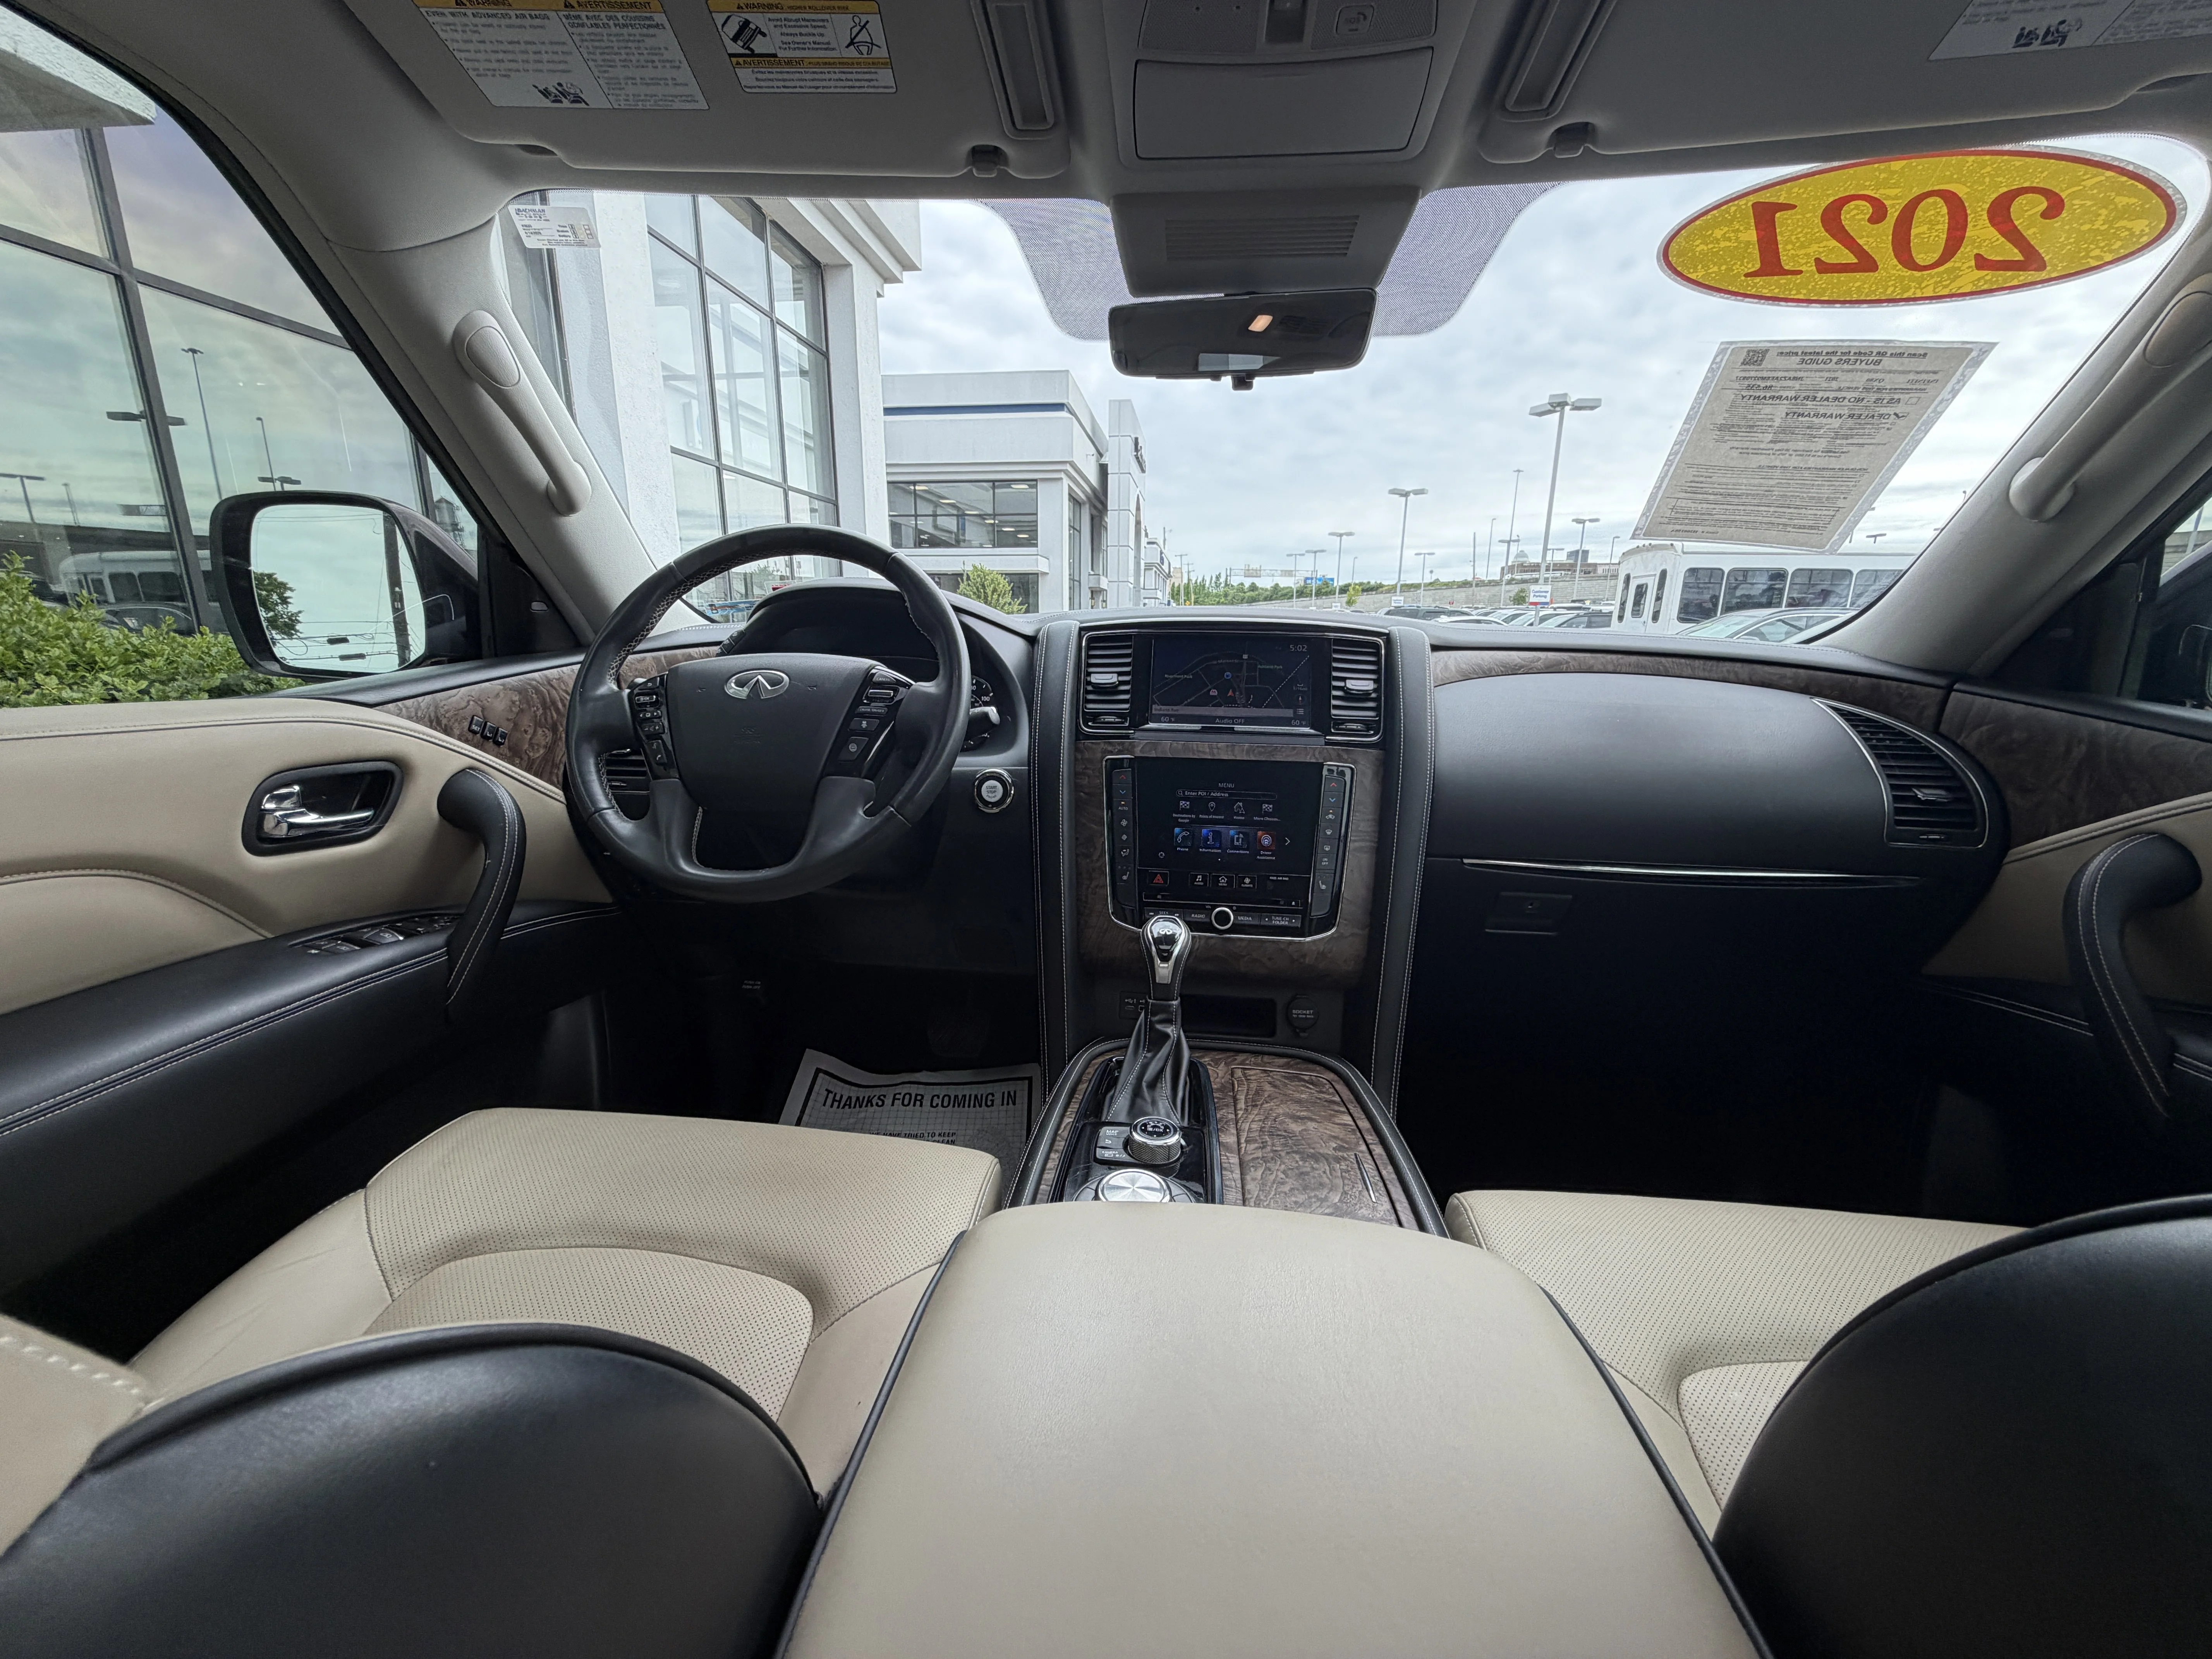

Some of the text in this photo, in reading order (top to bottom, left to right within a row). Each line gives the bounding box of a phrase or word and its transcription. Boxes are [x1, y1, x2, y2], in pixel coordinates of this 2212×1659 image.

[577, 1, 652, 9] AVERTISSEMENT
[823, 1088, 1017, 1109] THANKS FOR COMING IN
